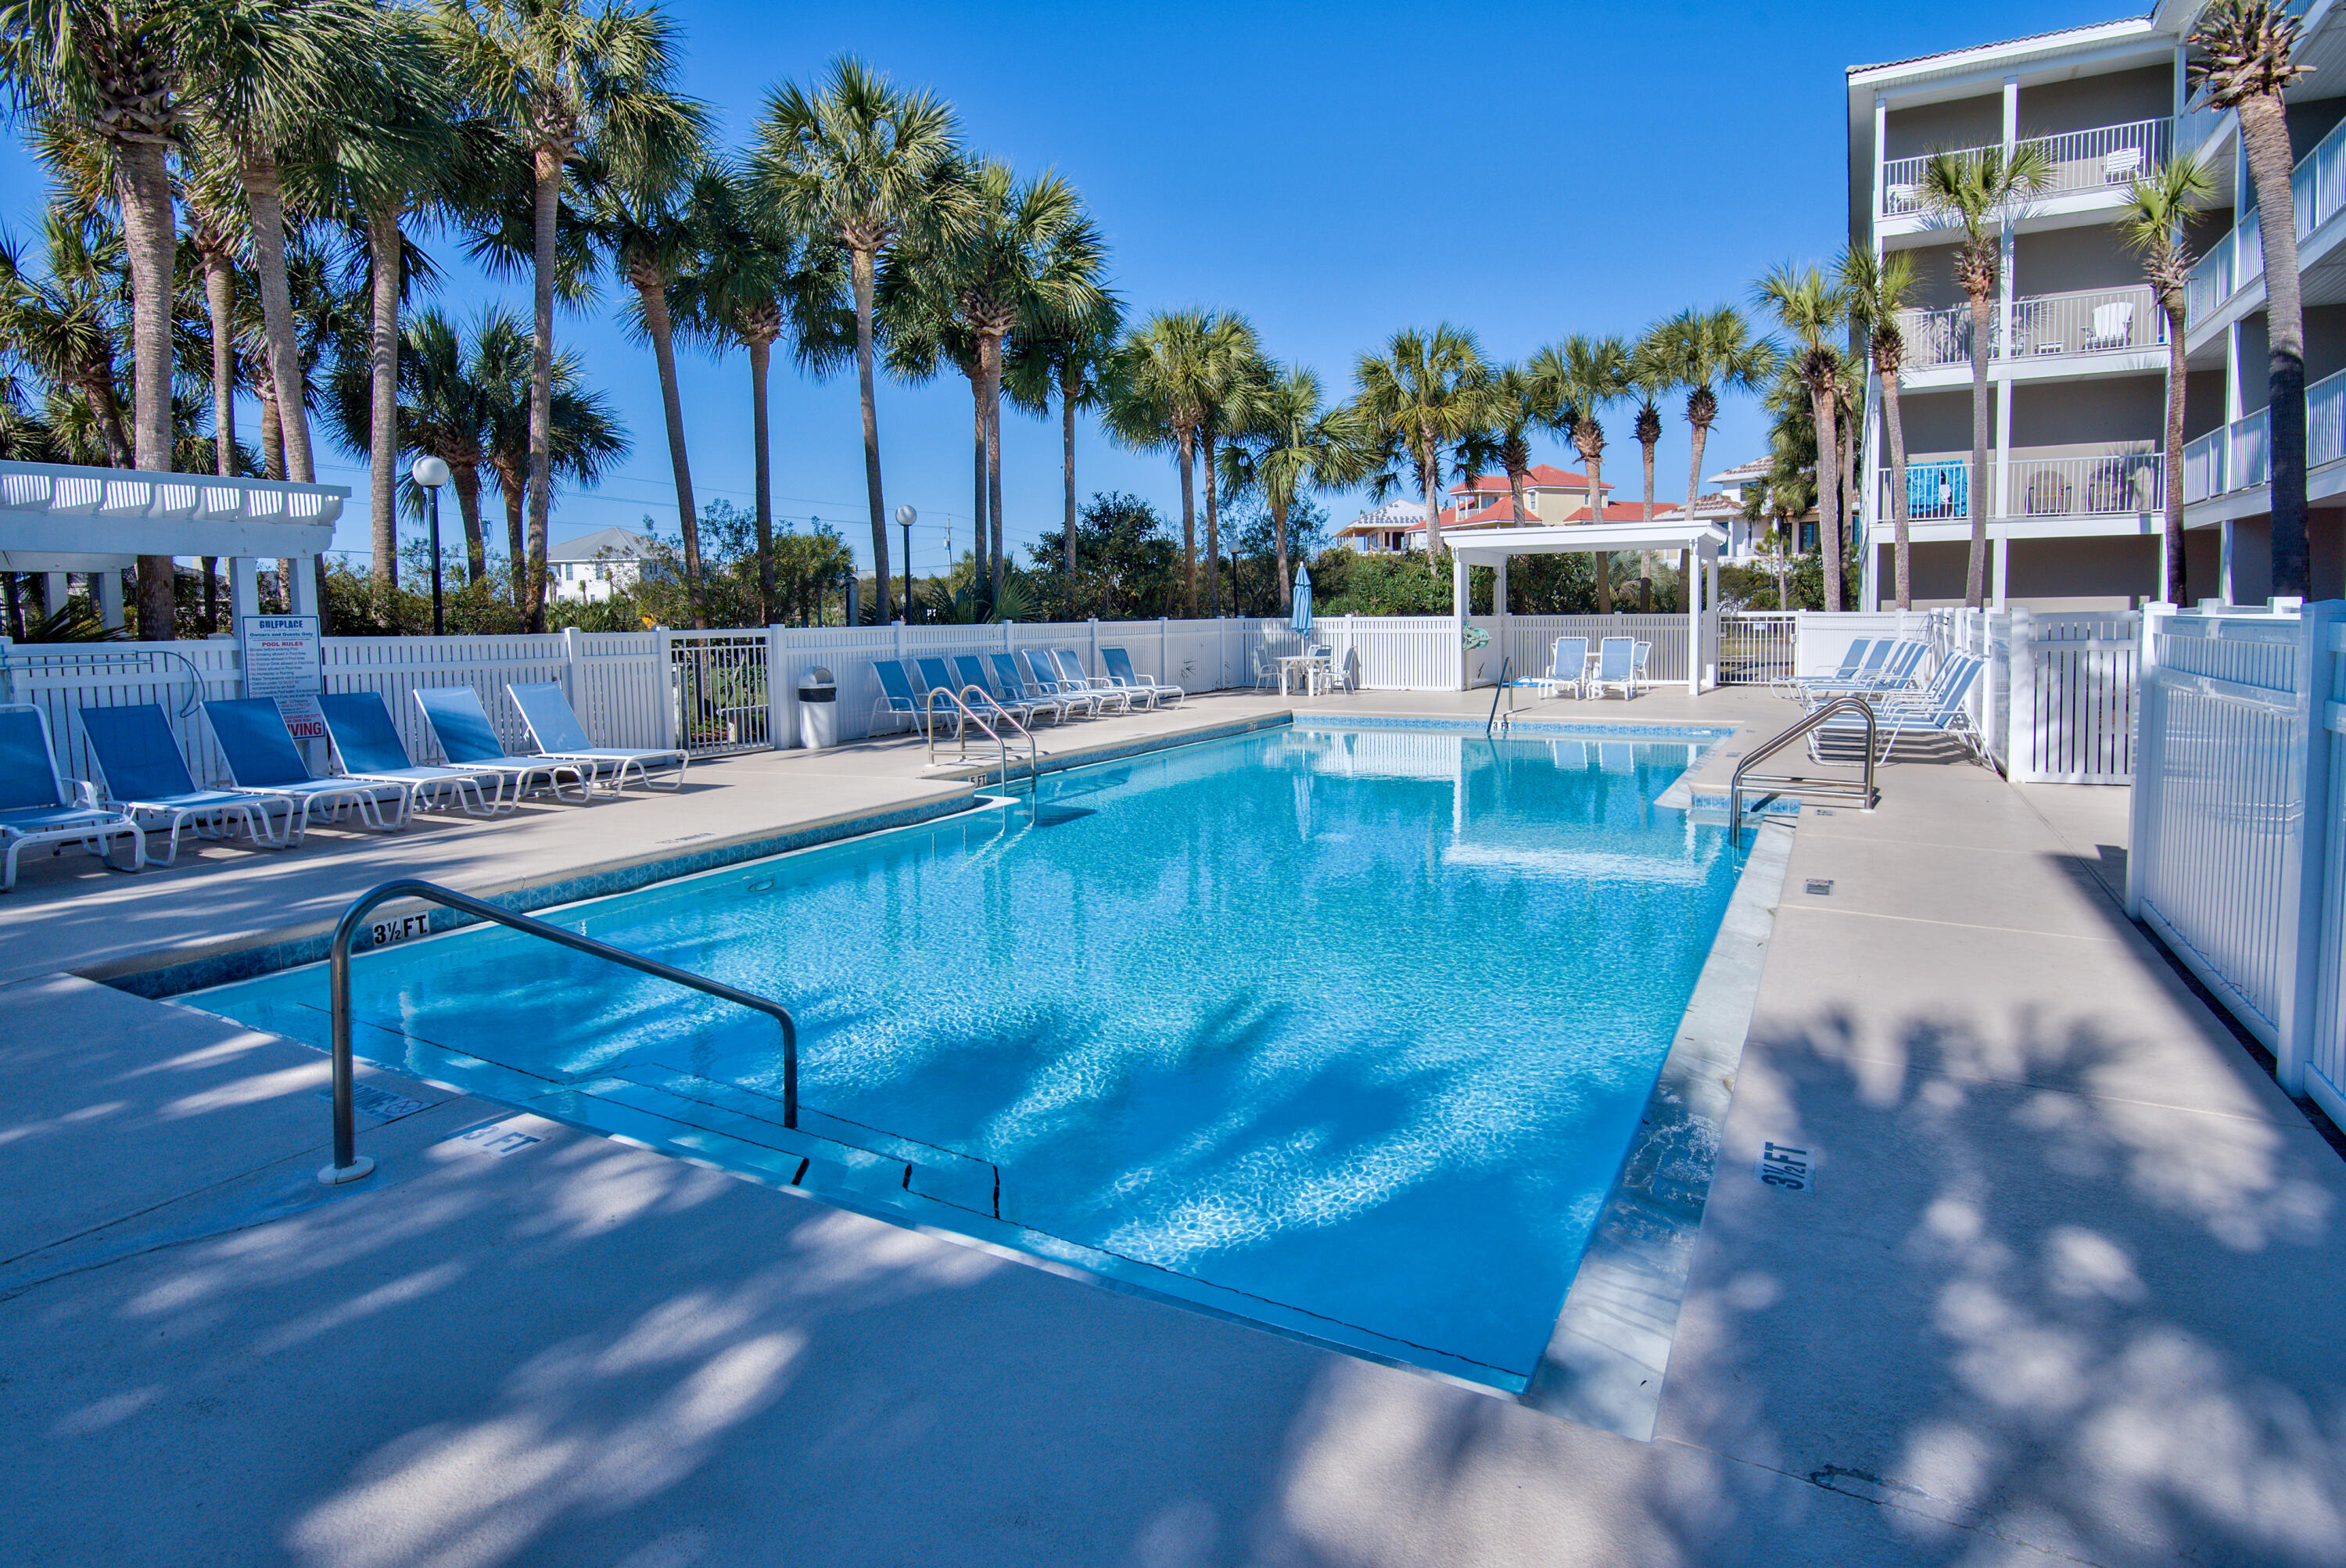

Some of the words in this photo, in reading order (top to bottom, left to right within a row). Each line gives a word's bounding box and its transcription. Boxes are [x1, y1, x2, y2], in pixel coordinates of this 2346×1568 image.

[259, 619, 303, 629] GULFPLACE
[978, 774, 986, 786] FT
[462, 1125, 500, 1140] 3
[482, 1132, 542, 1153] FT
